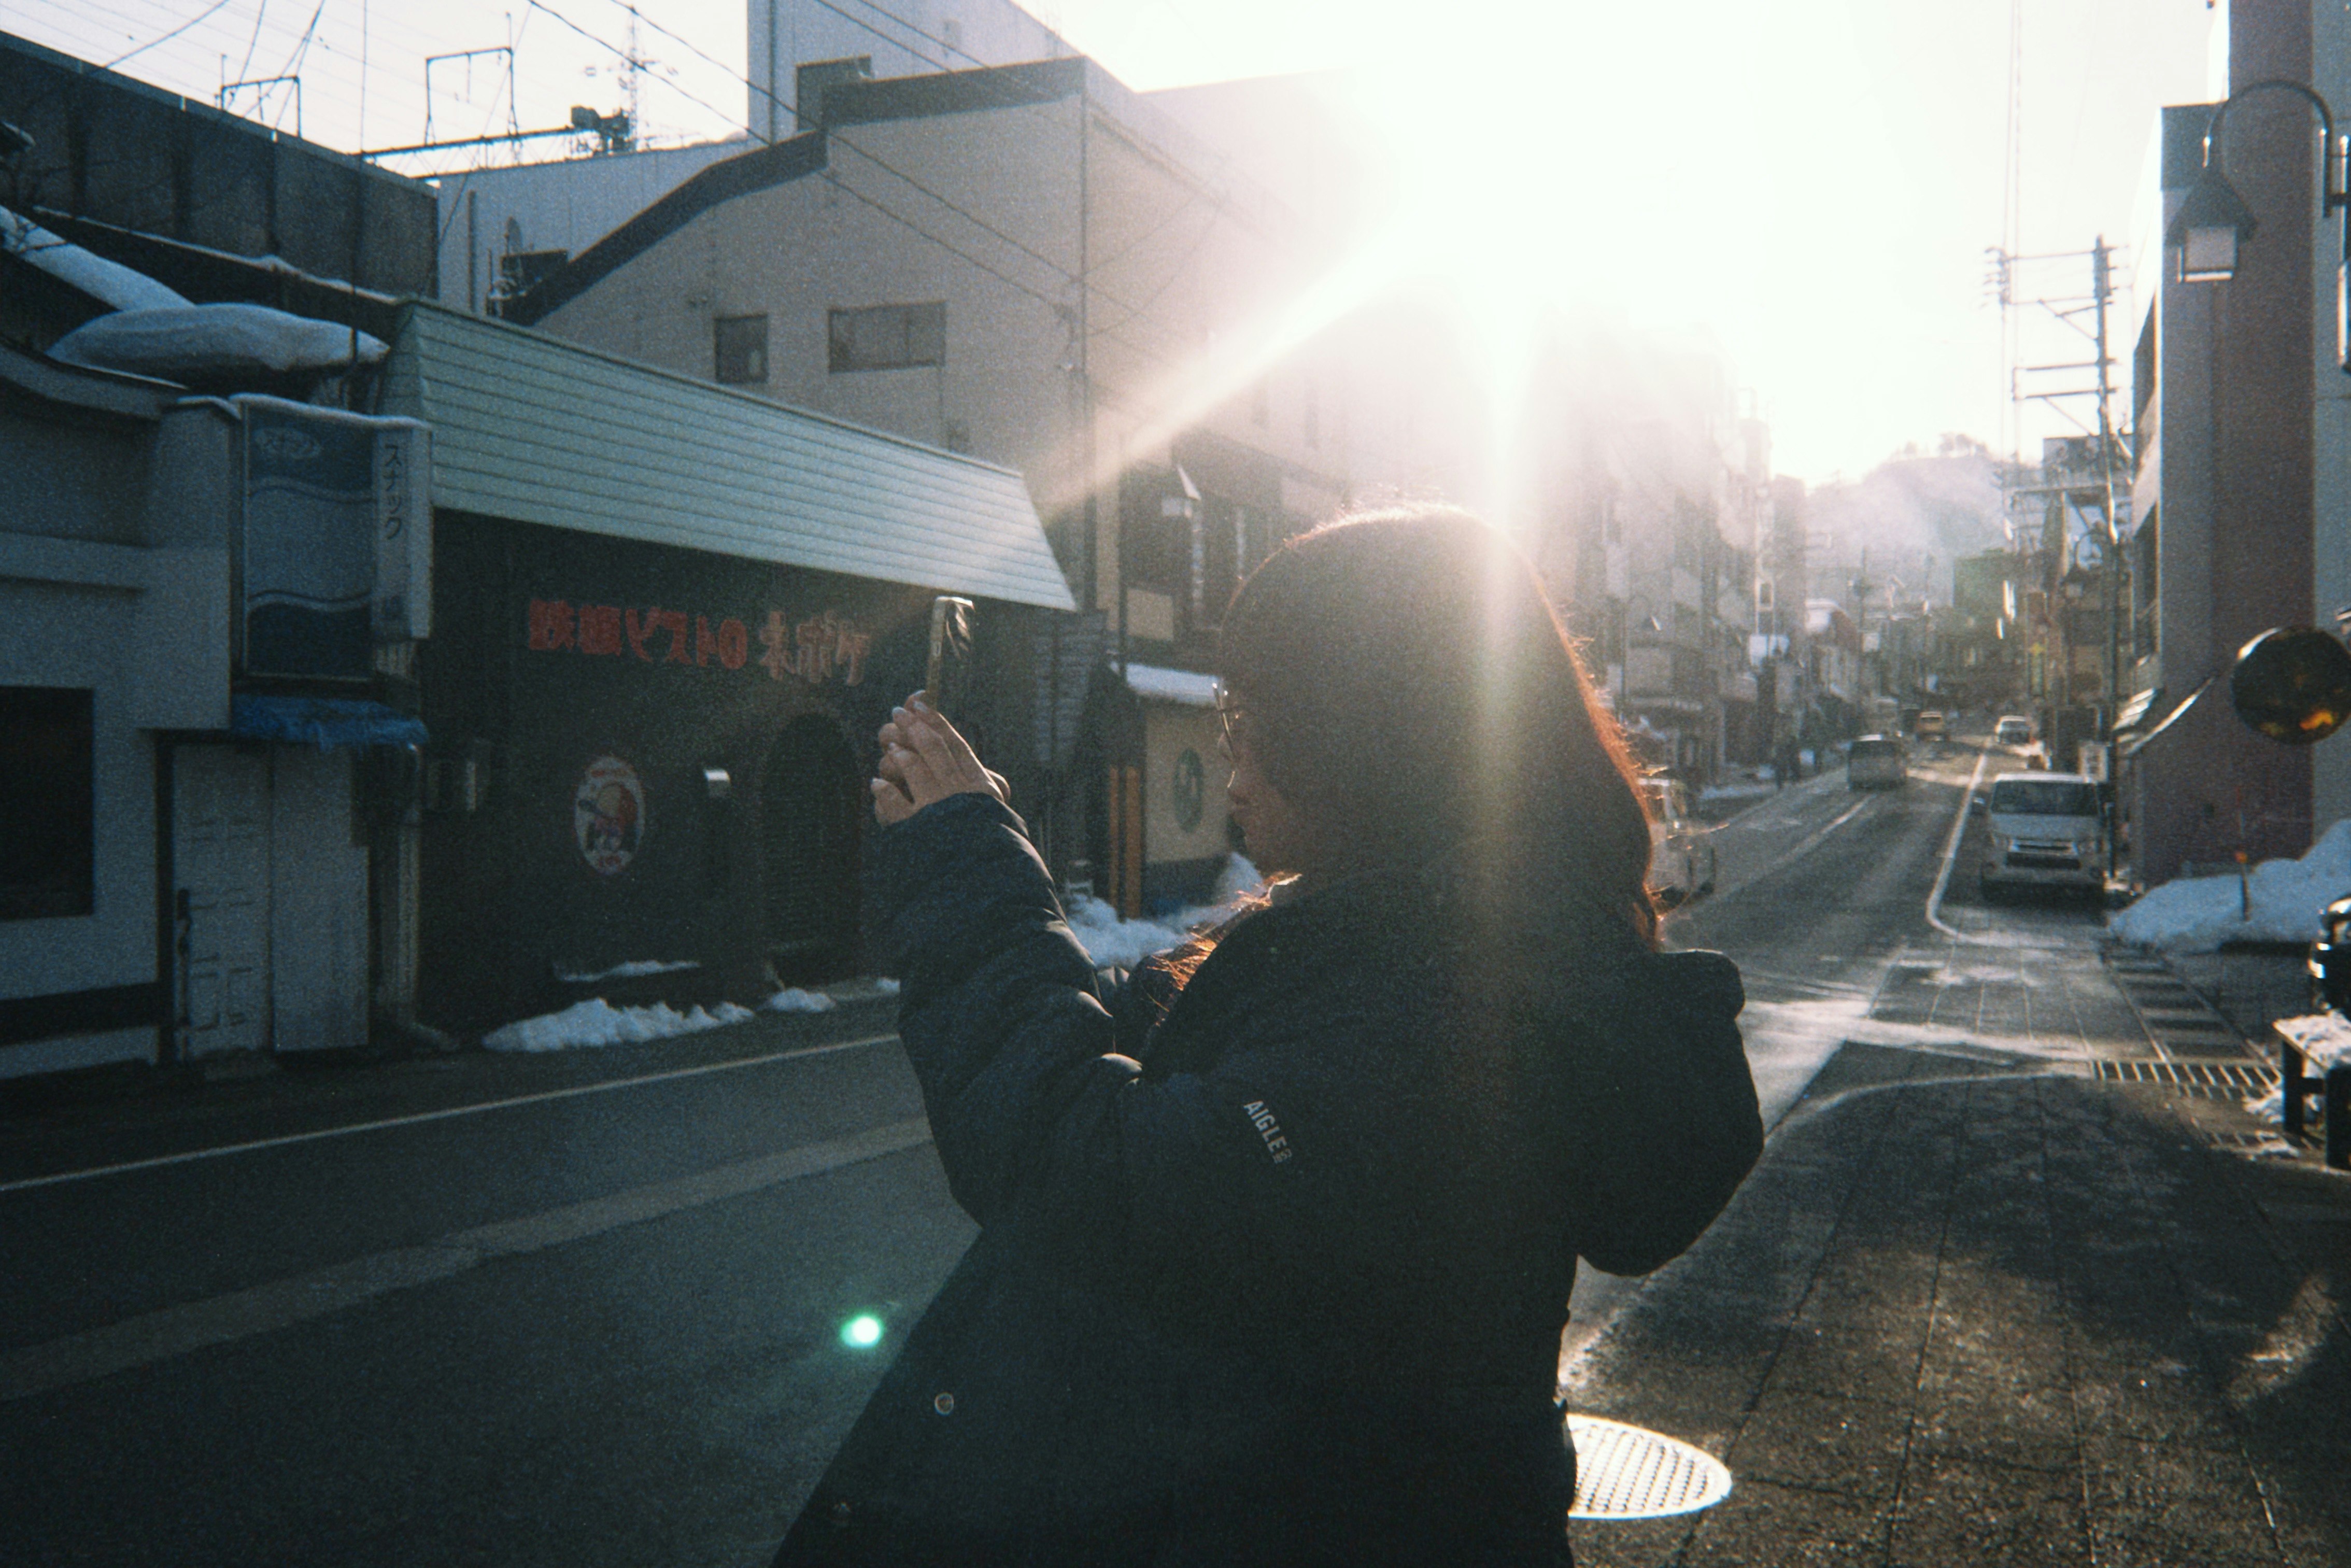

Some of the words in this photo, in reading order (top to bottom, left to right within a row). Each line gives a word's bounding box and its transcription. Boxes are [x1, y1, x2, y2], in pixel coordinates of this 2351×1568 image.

[384, 444, 403, 541] スナック
[1243, 1099, 1288, 1153] AIGLE
